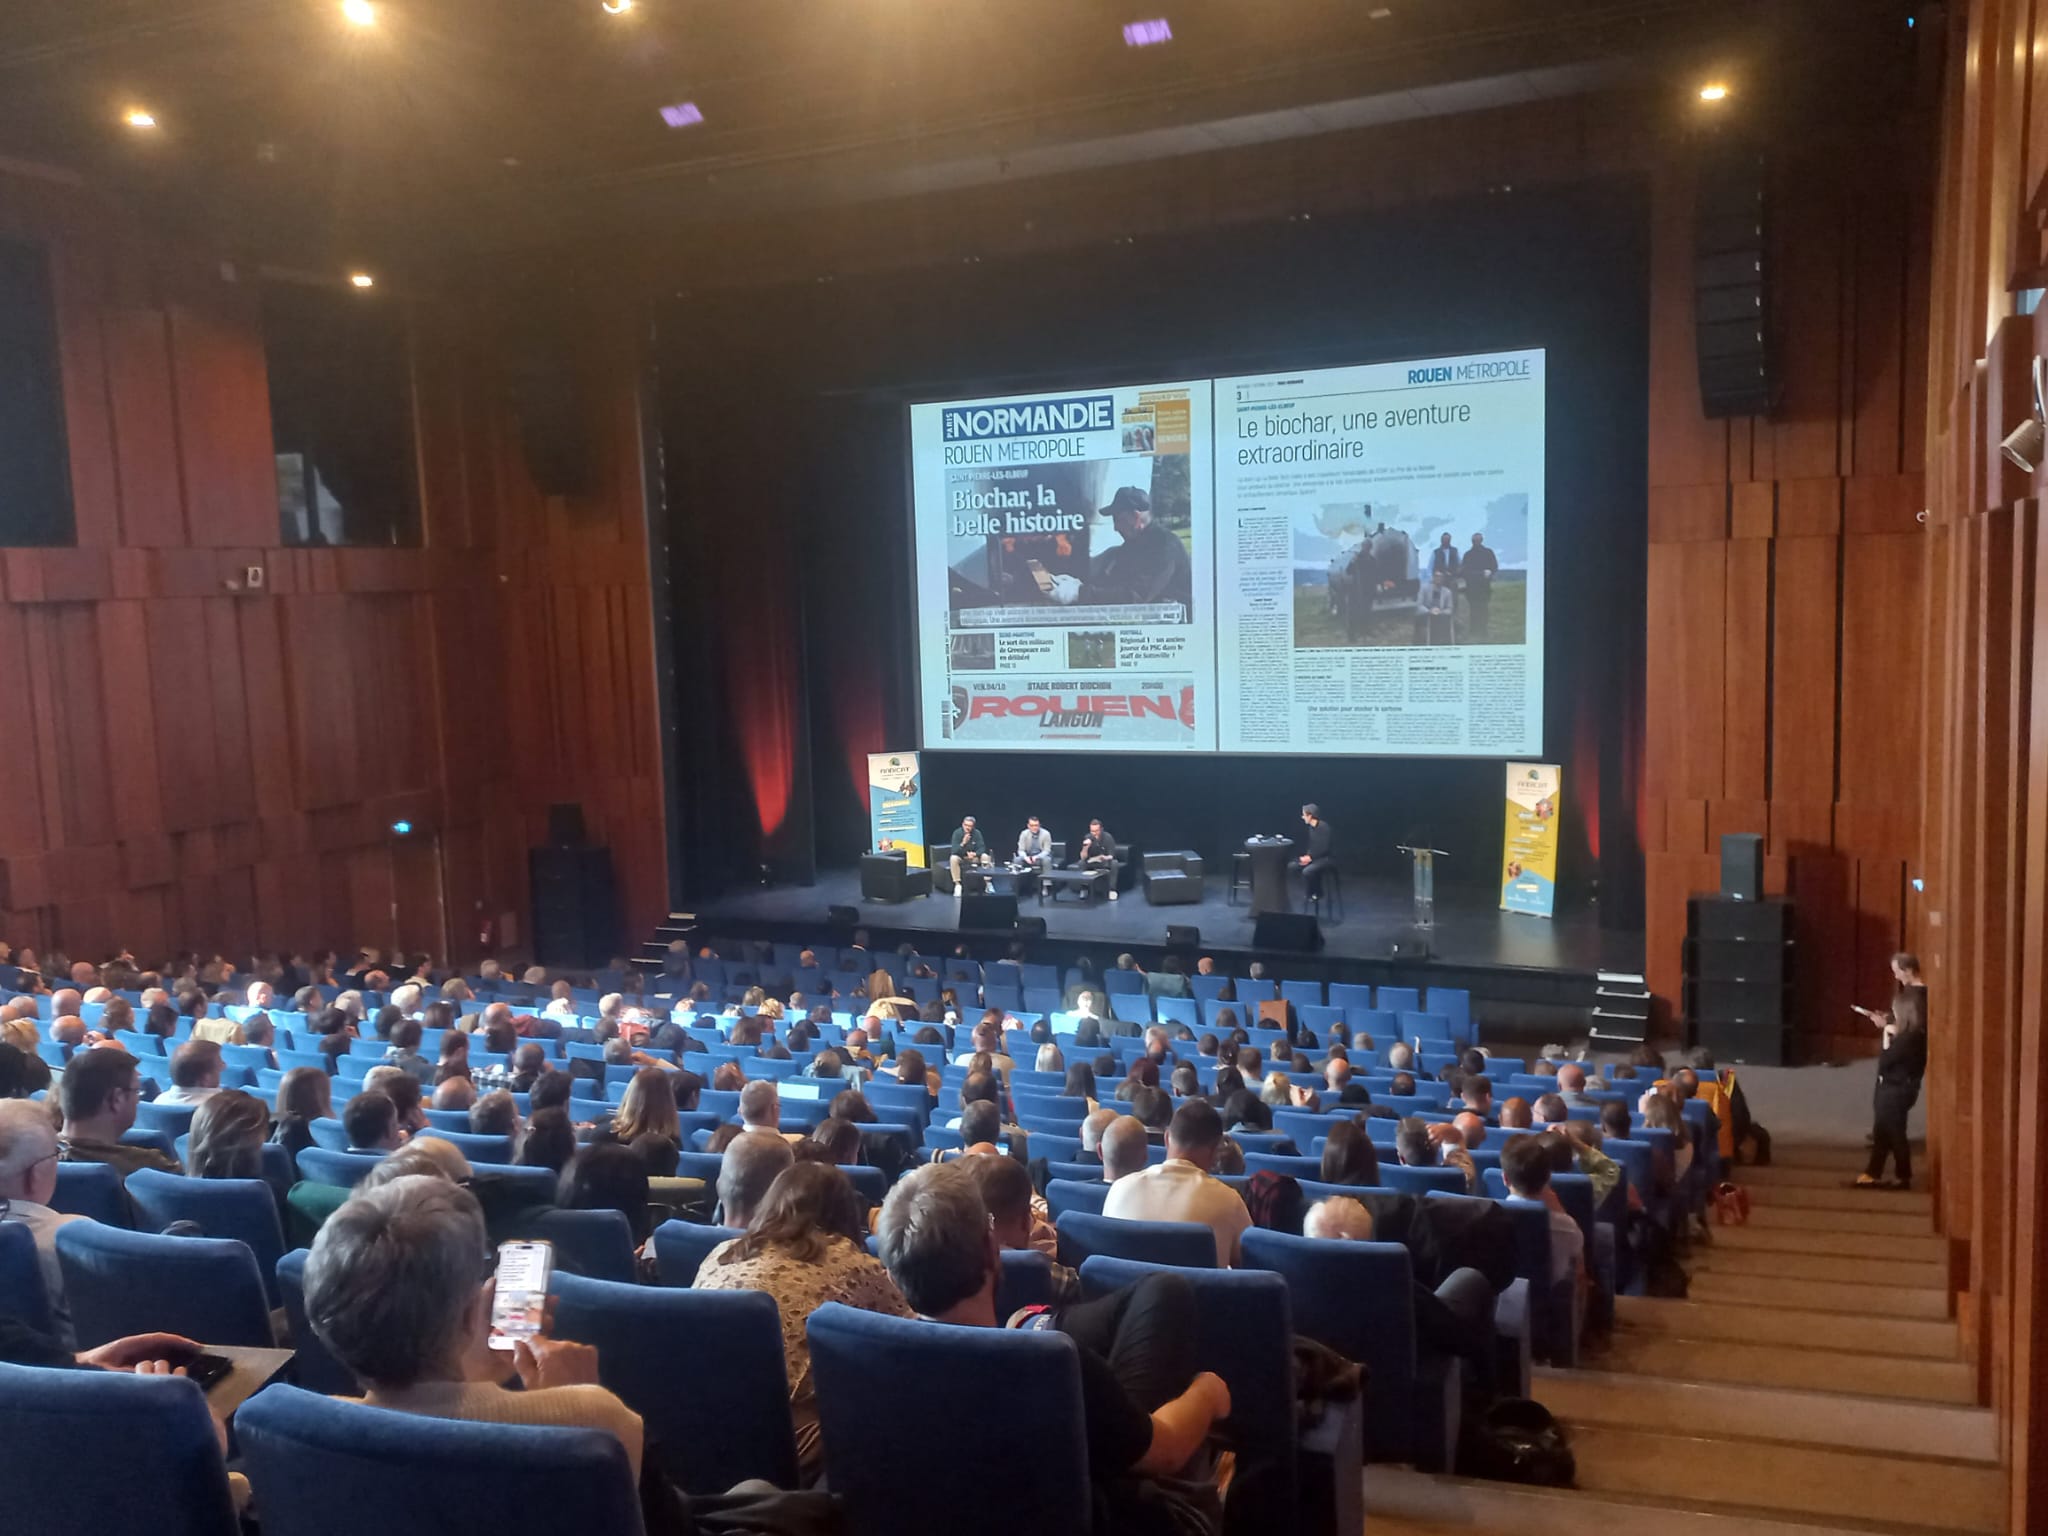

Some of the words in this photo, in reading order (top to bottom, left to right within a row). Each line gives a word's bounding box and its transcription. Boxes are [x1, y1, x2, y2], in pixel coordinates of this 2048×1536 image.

[1408, 366, 1452, 384] ROUEN
[1456, 359, 1530, 380] MÉTROPOLE
[1236, 391, 1242, 400] 3
[953, 400, 1112, 438] NORMANDIE
[1238, 417, 1258, 438] Le
[1265, 411, 1336, 437] biochar,
[1343, 411, 1377, 431] une
[1385, 403, 1471, 428] aventure
[945, 444, 992, 465] ROUEN
[1238, 437, 1363, 466] extraordinaire
[952, 486, 1032, 511] Biochar,
[1036, 483, 1056, 506] la
[953, 513, 1001, 536] belle
[1005, 509, 1084, 533] histoire
[969, 695, 1177, 720] ROUEN
[1039, 710, 1104, 728] LANGON
